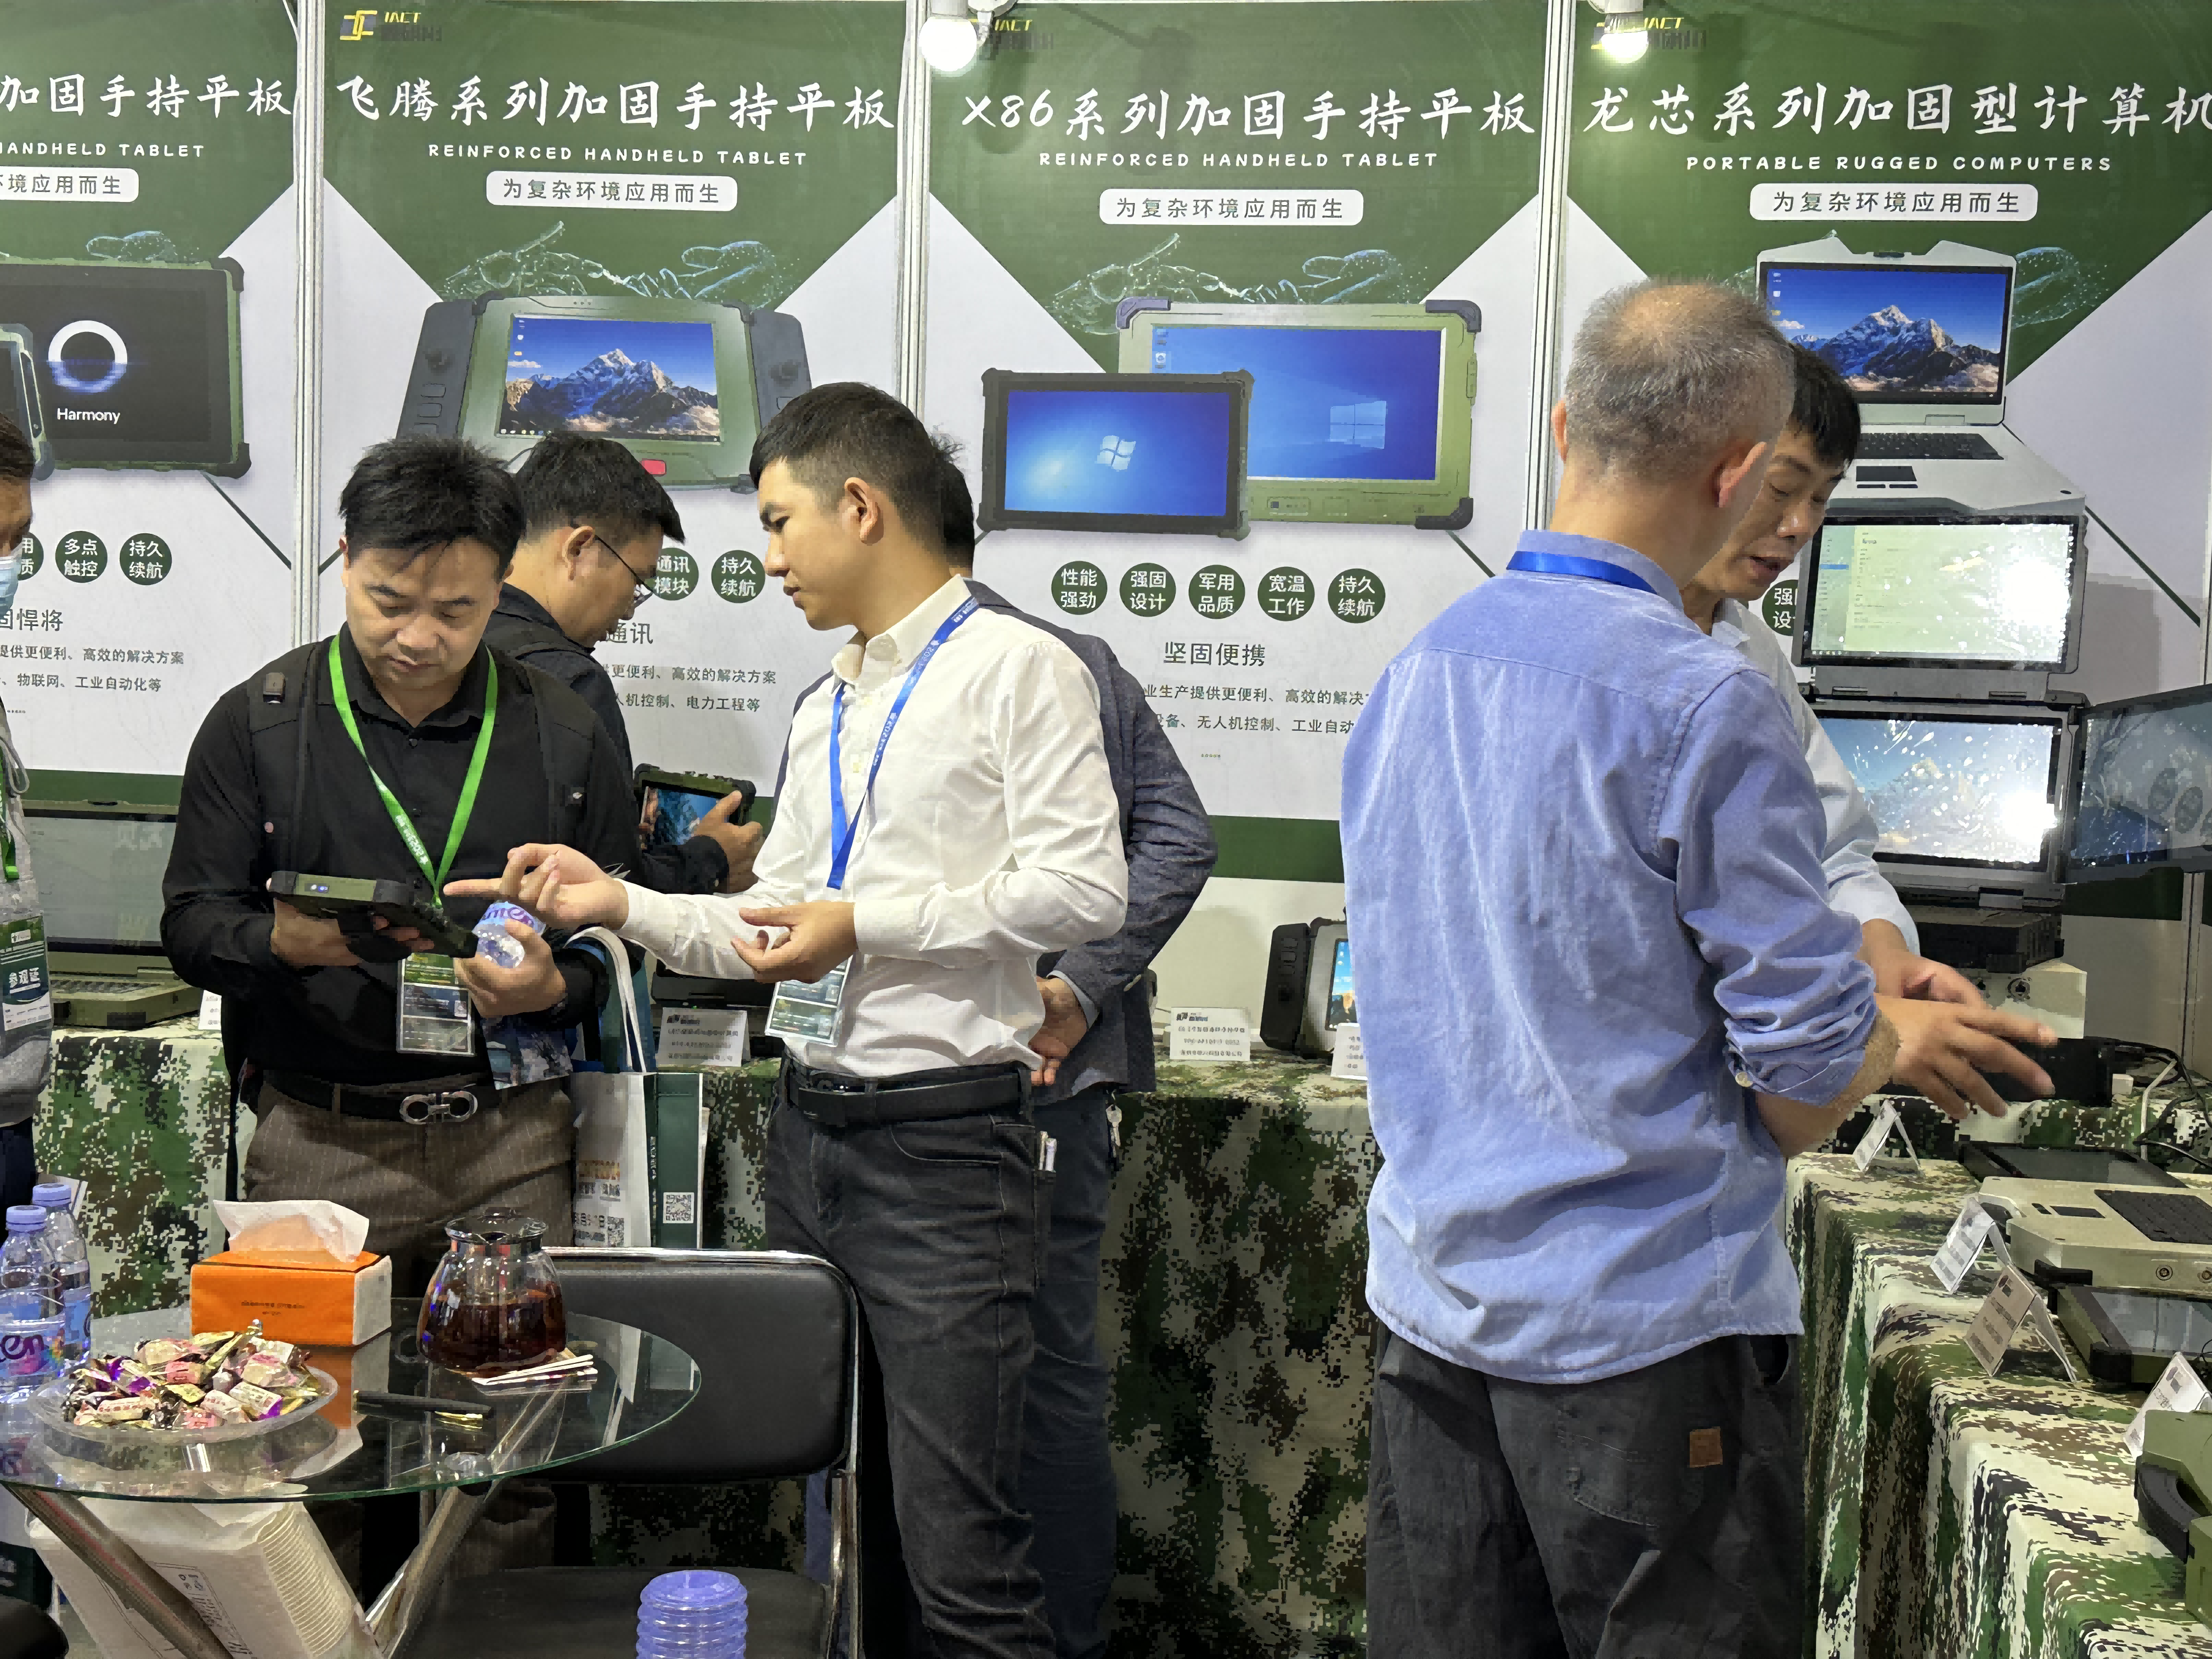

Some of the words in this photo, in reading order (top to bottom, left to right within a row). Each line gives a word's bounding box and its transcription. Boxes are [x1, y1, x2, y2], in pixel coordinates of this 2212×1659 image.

[0, 73, 291, 119] 加固手持平板
[336, 75, 894, 132] 飞腾系列加固手持平板
[962, 87, 1536, 141] X86系列加固手持平板
[1583, 81, 2212, 137] 龙芯系列加固型计算机
[0, 142, 106, 156] ANDHELD
[119, 144, 205, 158] TABLET
[428, 144, 572, 160] REINFORCED
[584, 148, 704, 163] HANDHELD
[717, 150, 807, 165] TABLET
[1039, 153, 1189, 166] REINFORCED
[1203, 153, 1328, 167] HANDHELD
[1342, 153, 1437, 167] TABLET
[1686, 156, 1820, 170] PORTABLE
[1836, 156, 1938, 170] RUGGED
[1953, 156, 2111, 171] COMPUTERS
[0, 174, 121, 195] 境应用而生
[503, 178, 719, 204] 为复杂环境应用而生
[1116, 198, 1343, 219] 为复杂环境应用而生
[1773, 191, 2019, 213] 为复杂环境应用而生
[57, 408, 121, 425] Harmony
[64, 538, 98, 556] 多点
[129, 539, 163, 558] 持久
[64, 560, 98, 577] 触控
[129, 561, 163, 579] 续航
[657, 555, 690, 573] 通讯
[721, 557, 757, 574] 持久
[654, 576, 690, 595] 模块
[1060, 568, 1098, 586] 性能
[1130, 571, 1166, 589] 强固
[1199, 573, 1235, 591] 军用
[1268, 574, 1305, 592] 宽温
[1338, 575, 1375, 594] 持久
[720, 579, 757, 597] 续航
[1774, 588, 1798, 606] 强
[1060, 591, 1096, 608] 强劲
[1130, 592, 1166, 611] 设计
[1198, 596, 1235, 613] 品质
[1267, 597, 1305, 615] 工作
[1338, 598, 1375, 617] 续航
[1773, 611, 1796, 629] 设
[606, 622, 653, 645] 通讯
[1163, 641, 1266, 667] 坚固便携
[1143, 684, 1369, 706] 业生产提供更便利、高效的解决
